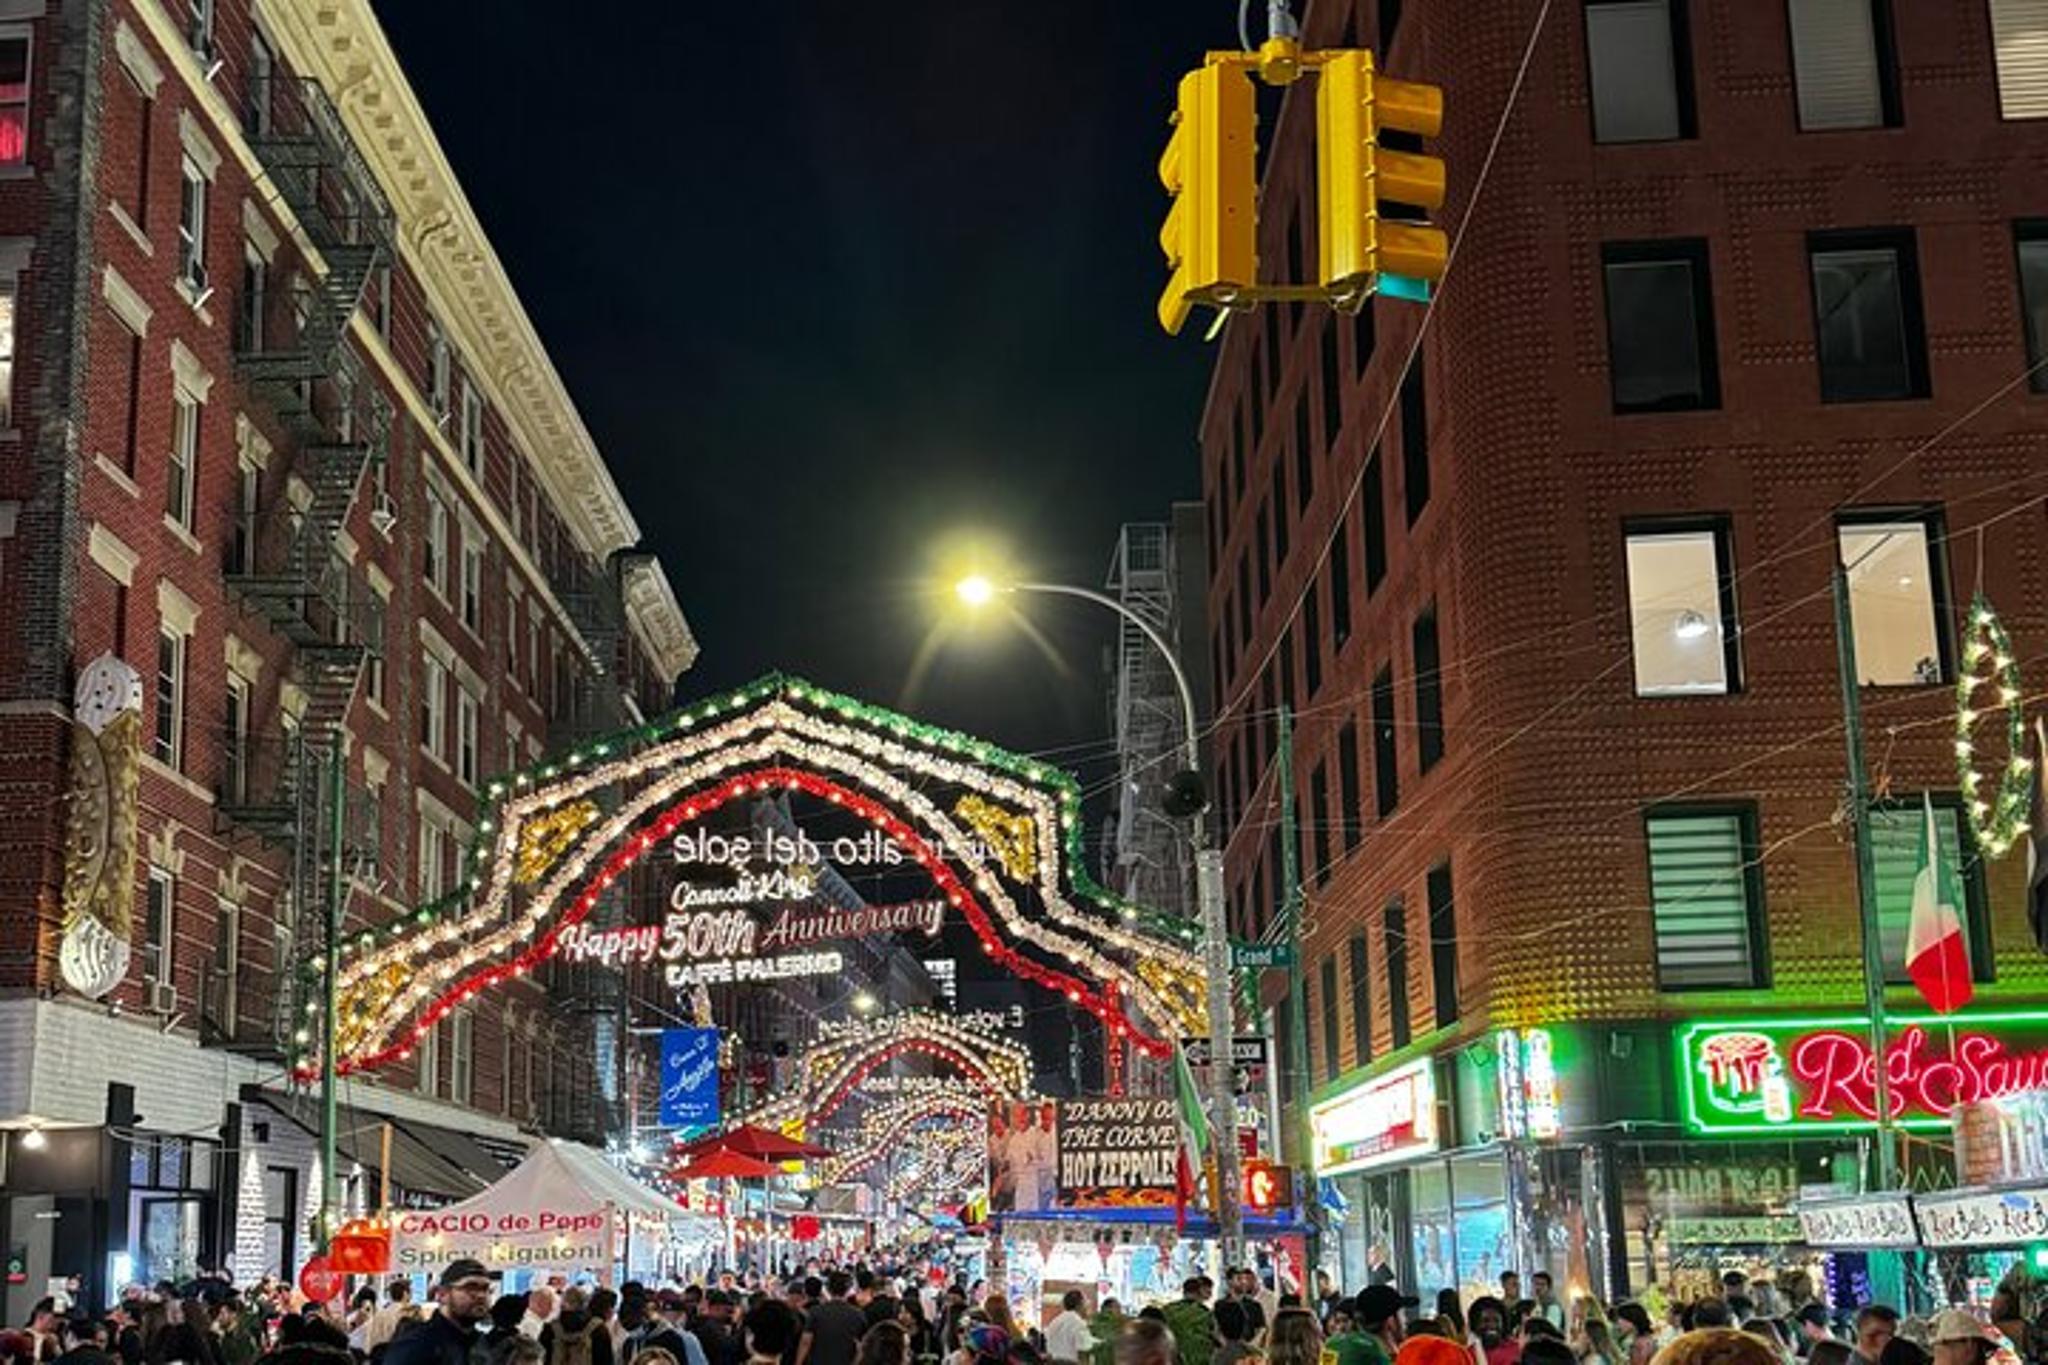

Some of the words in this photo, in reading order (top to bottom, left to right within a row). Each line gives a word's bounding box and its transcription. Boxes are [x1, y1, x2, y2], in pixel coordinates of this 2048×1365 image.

[558, 922, 661, 966] Happy
[659, 910, 755, 959] 50th
[761, 900, 943, 947] Anniversary
[736, 952, 843, 982] PALERMO
[1237, 948, 1272, 965] Grand
[1920, 1036, 2048, 1113] Sau
[1064, 1101, 1150, 1123] DANNY
[1062, 1125, 1104, 1148] THE
[1106, 1125, 1177, 1147] CORNE
[1062, 1152, 1096, 1187] HOT
[1099, 1151, 1178, 1187] ZEPPOLE
[401, 1212, 489, 1233] CACIO
[497, 1213, 530, 1231] de
[539, 1211, 604, 1232] Pepe
